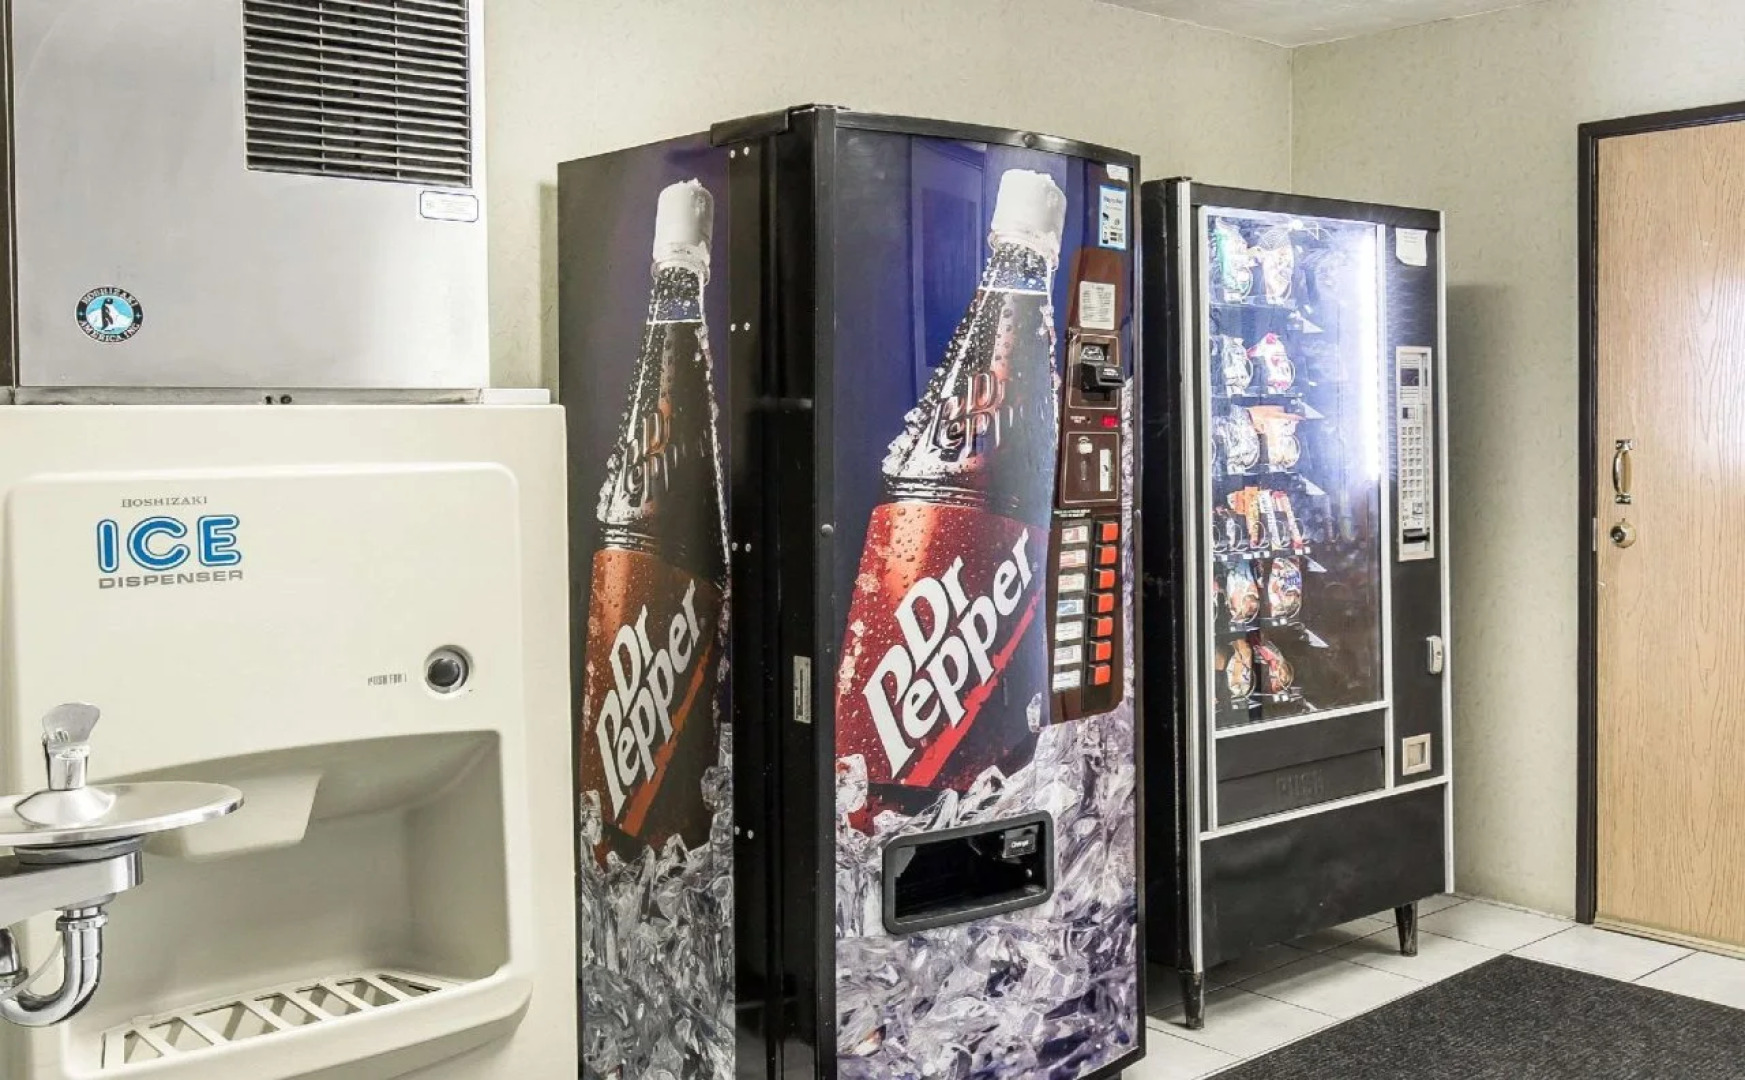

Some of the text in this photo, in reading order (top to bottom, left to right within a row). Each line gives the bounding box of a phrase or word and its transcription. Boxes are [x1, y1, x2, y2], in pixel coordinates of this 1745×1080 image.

[97, 514, 241, 573] ICE
[120, 496, 208, 508] HOSHIZAKI
[98, 570, 243, 589] DISPENSER
[894, 555, 970, 670] Dr
[596, 578, 700, 820] Pepper
[609, 604, 653, 717] Dr
[862, 528, 1032, 778] Pepper
